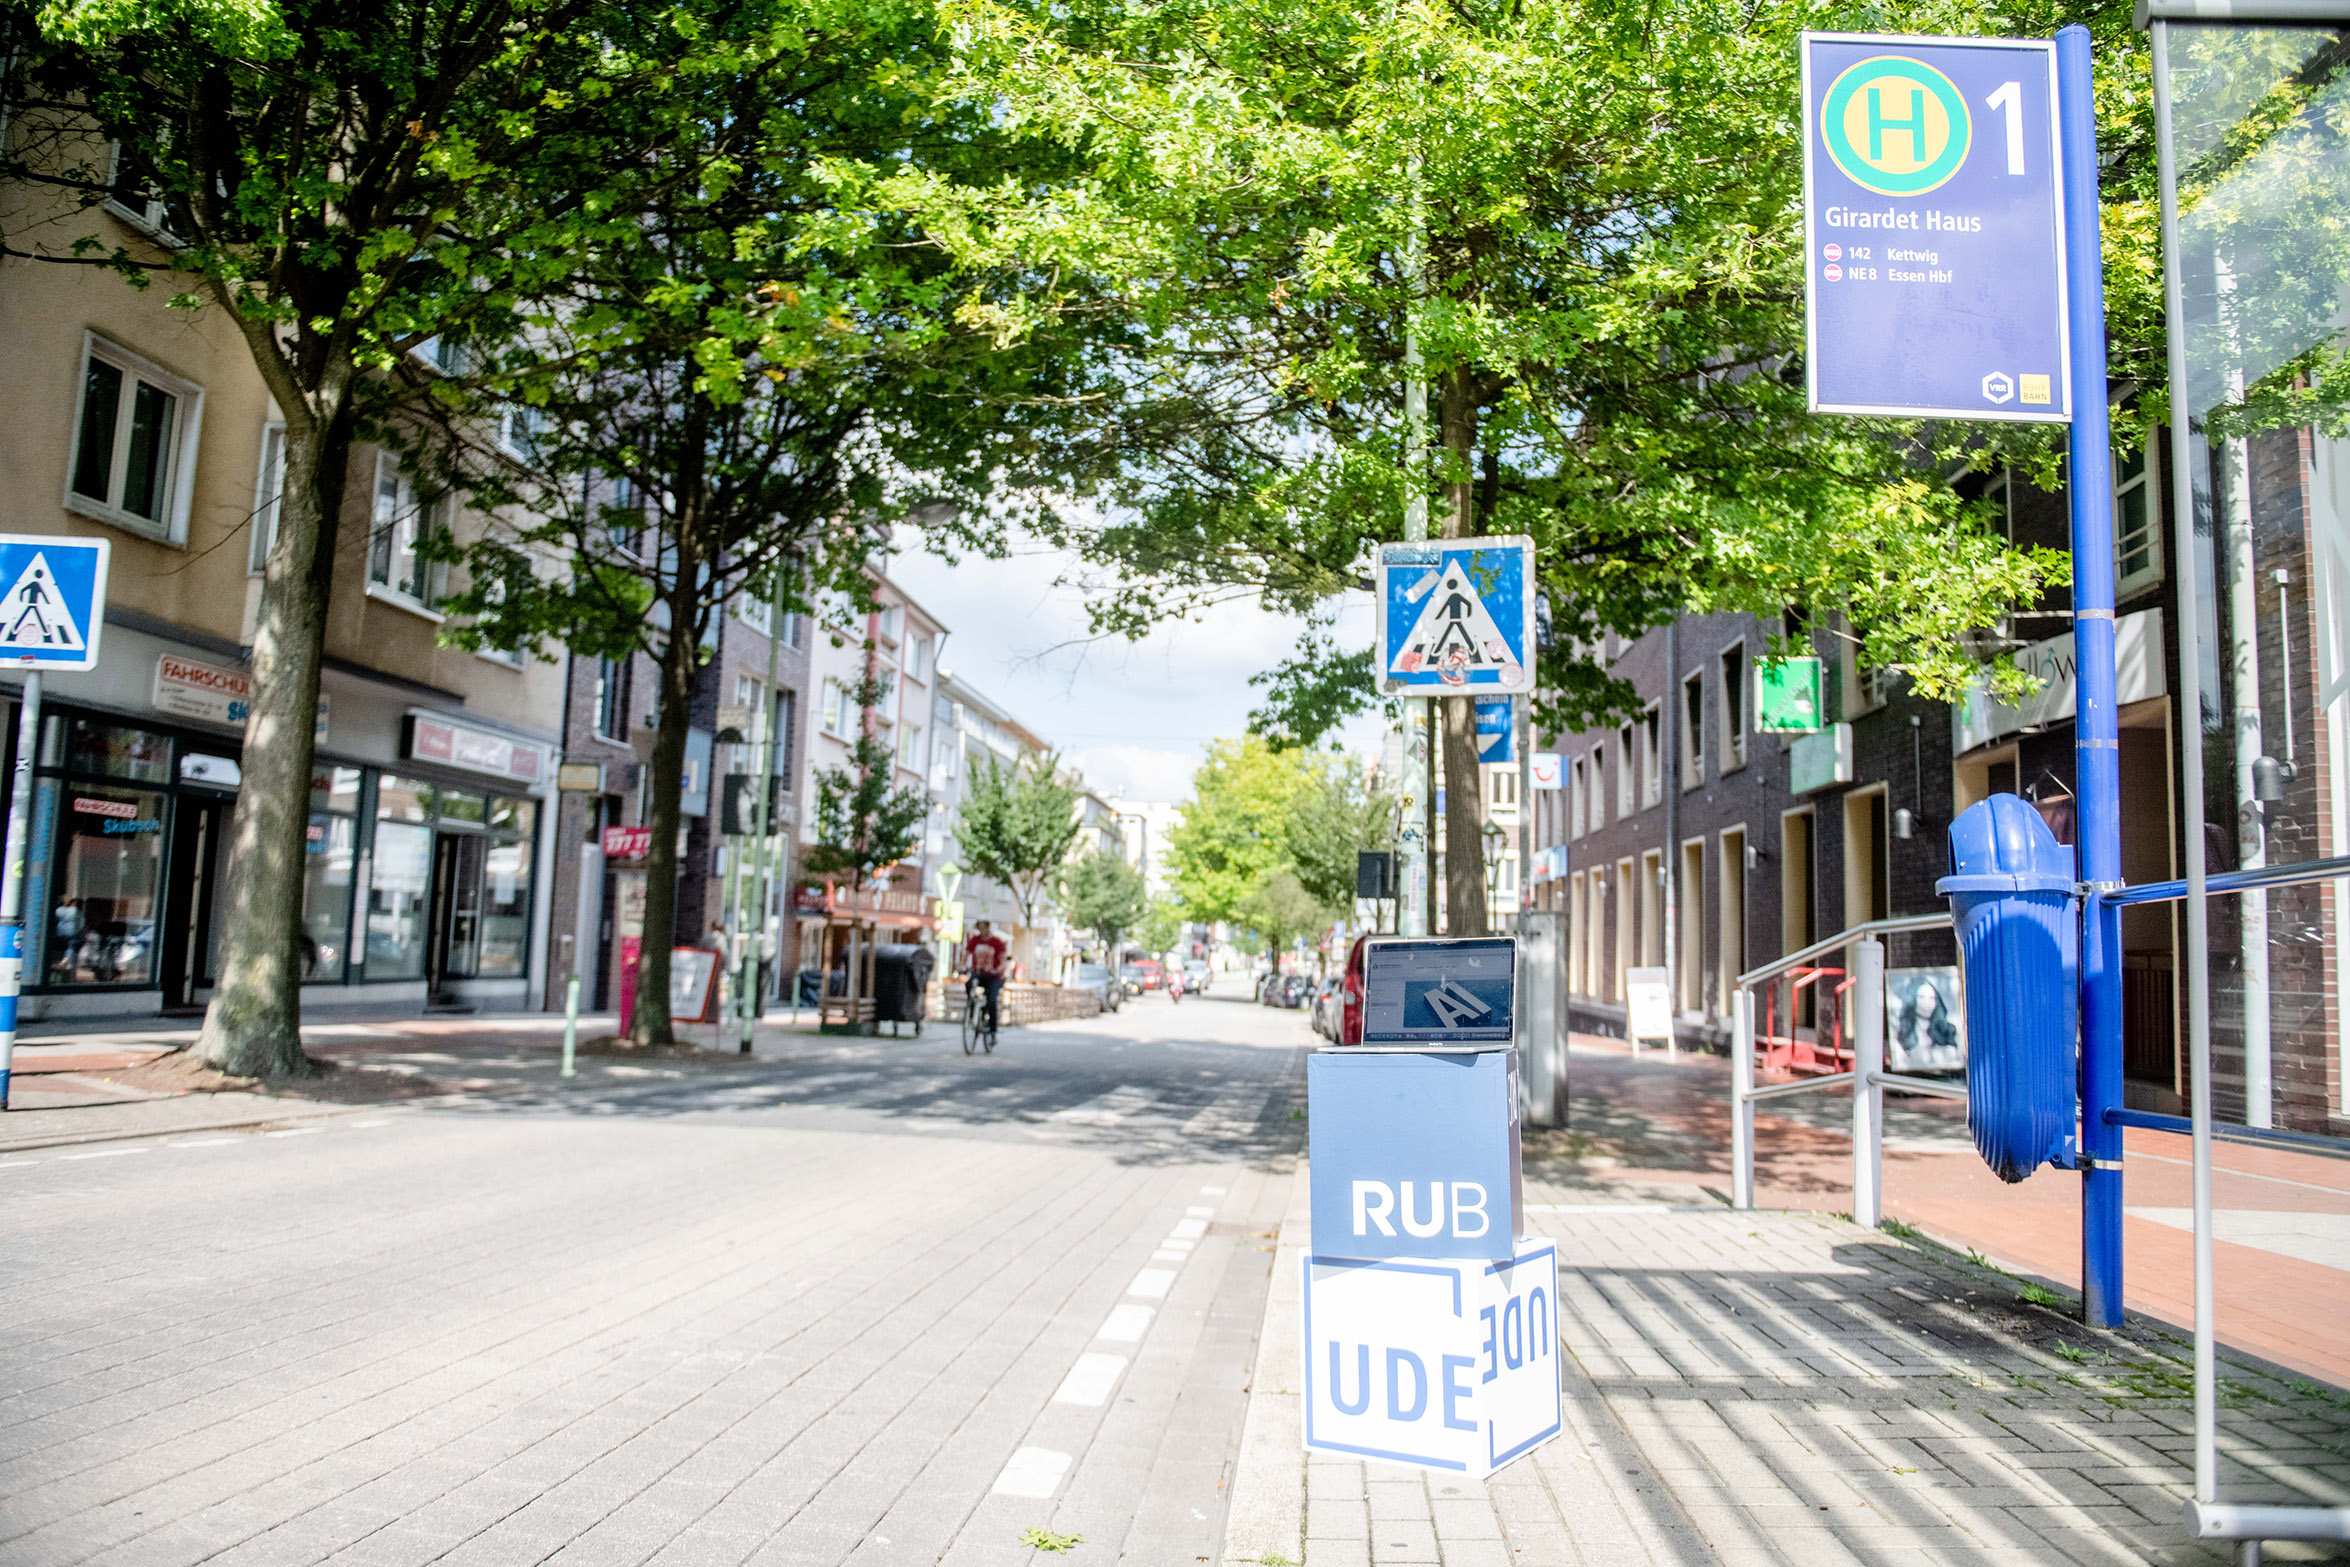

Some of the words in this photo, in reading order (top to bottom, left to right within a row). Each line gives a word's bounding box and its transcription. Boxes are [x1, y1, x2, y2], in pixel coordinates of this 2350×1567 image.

[1867, 88, 1926, 162] H
[1985, 81, 2025, 176] 1
[1825, 206, 1919, 230] Girardet
[1926, 210, 1982, 232] Haus
[1848, 247, 1871, 260] 142
[1887, 248, 1938, 265] Kettwig
[1888, 268, 1926, 282] Essen
[1929, 269, 1953, 283] Hbf
[1989, 383, 2007, 392] VRR
[2023, 392, 2047, 401] BAHN
[1423, 980, 1492, 1029] AI
[1352, 1180, 1490, 1239] RUB
[1480, 1285, 1549, 1386] UDE
[1328, 1340, 1478, 1433] UDE
